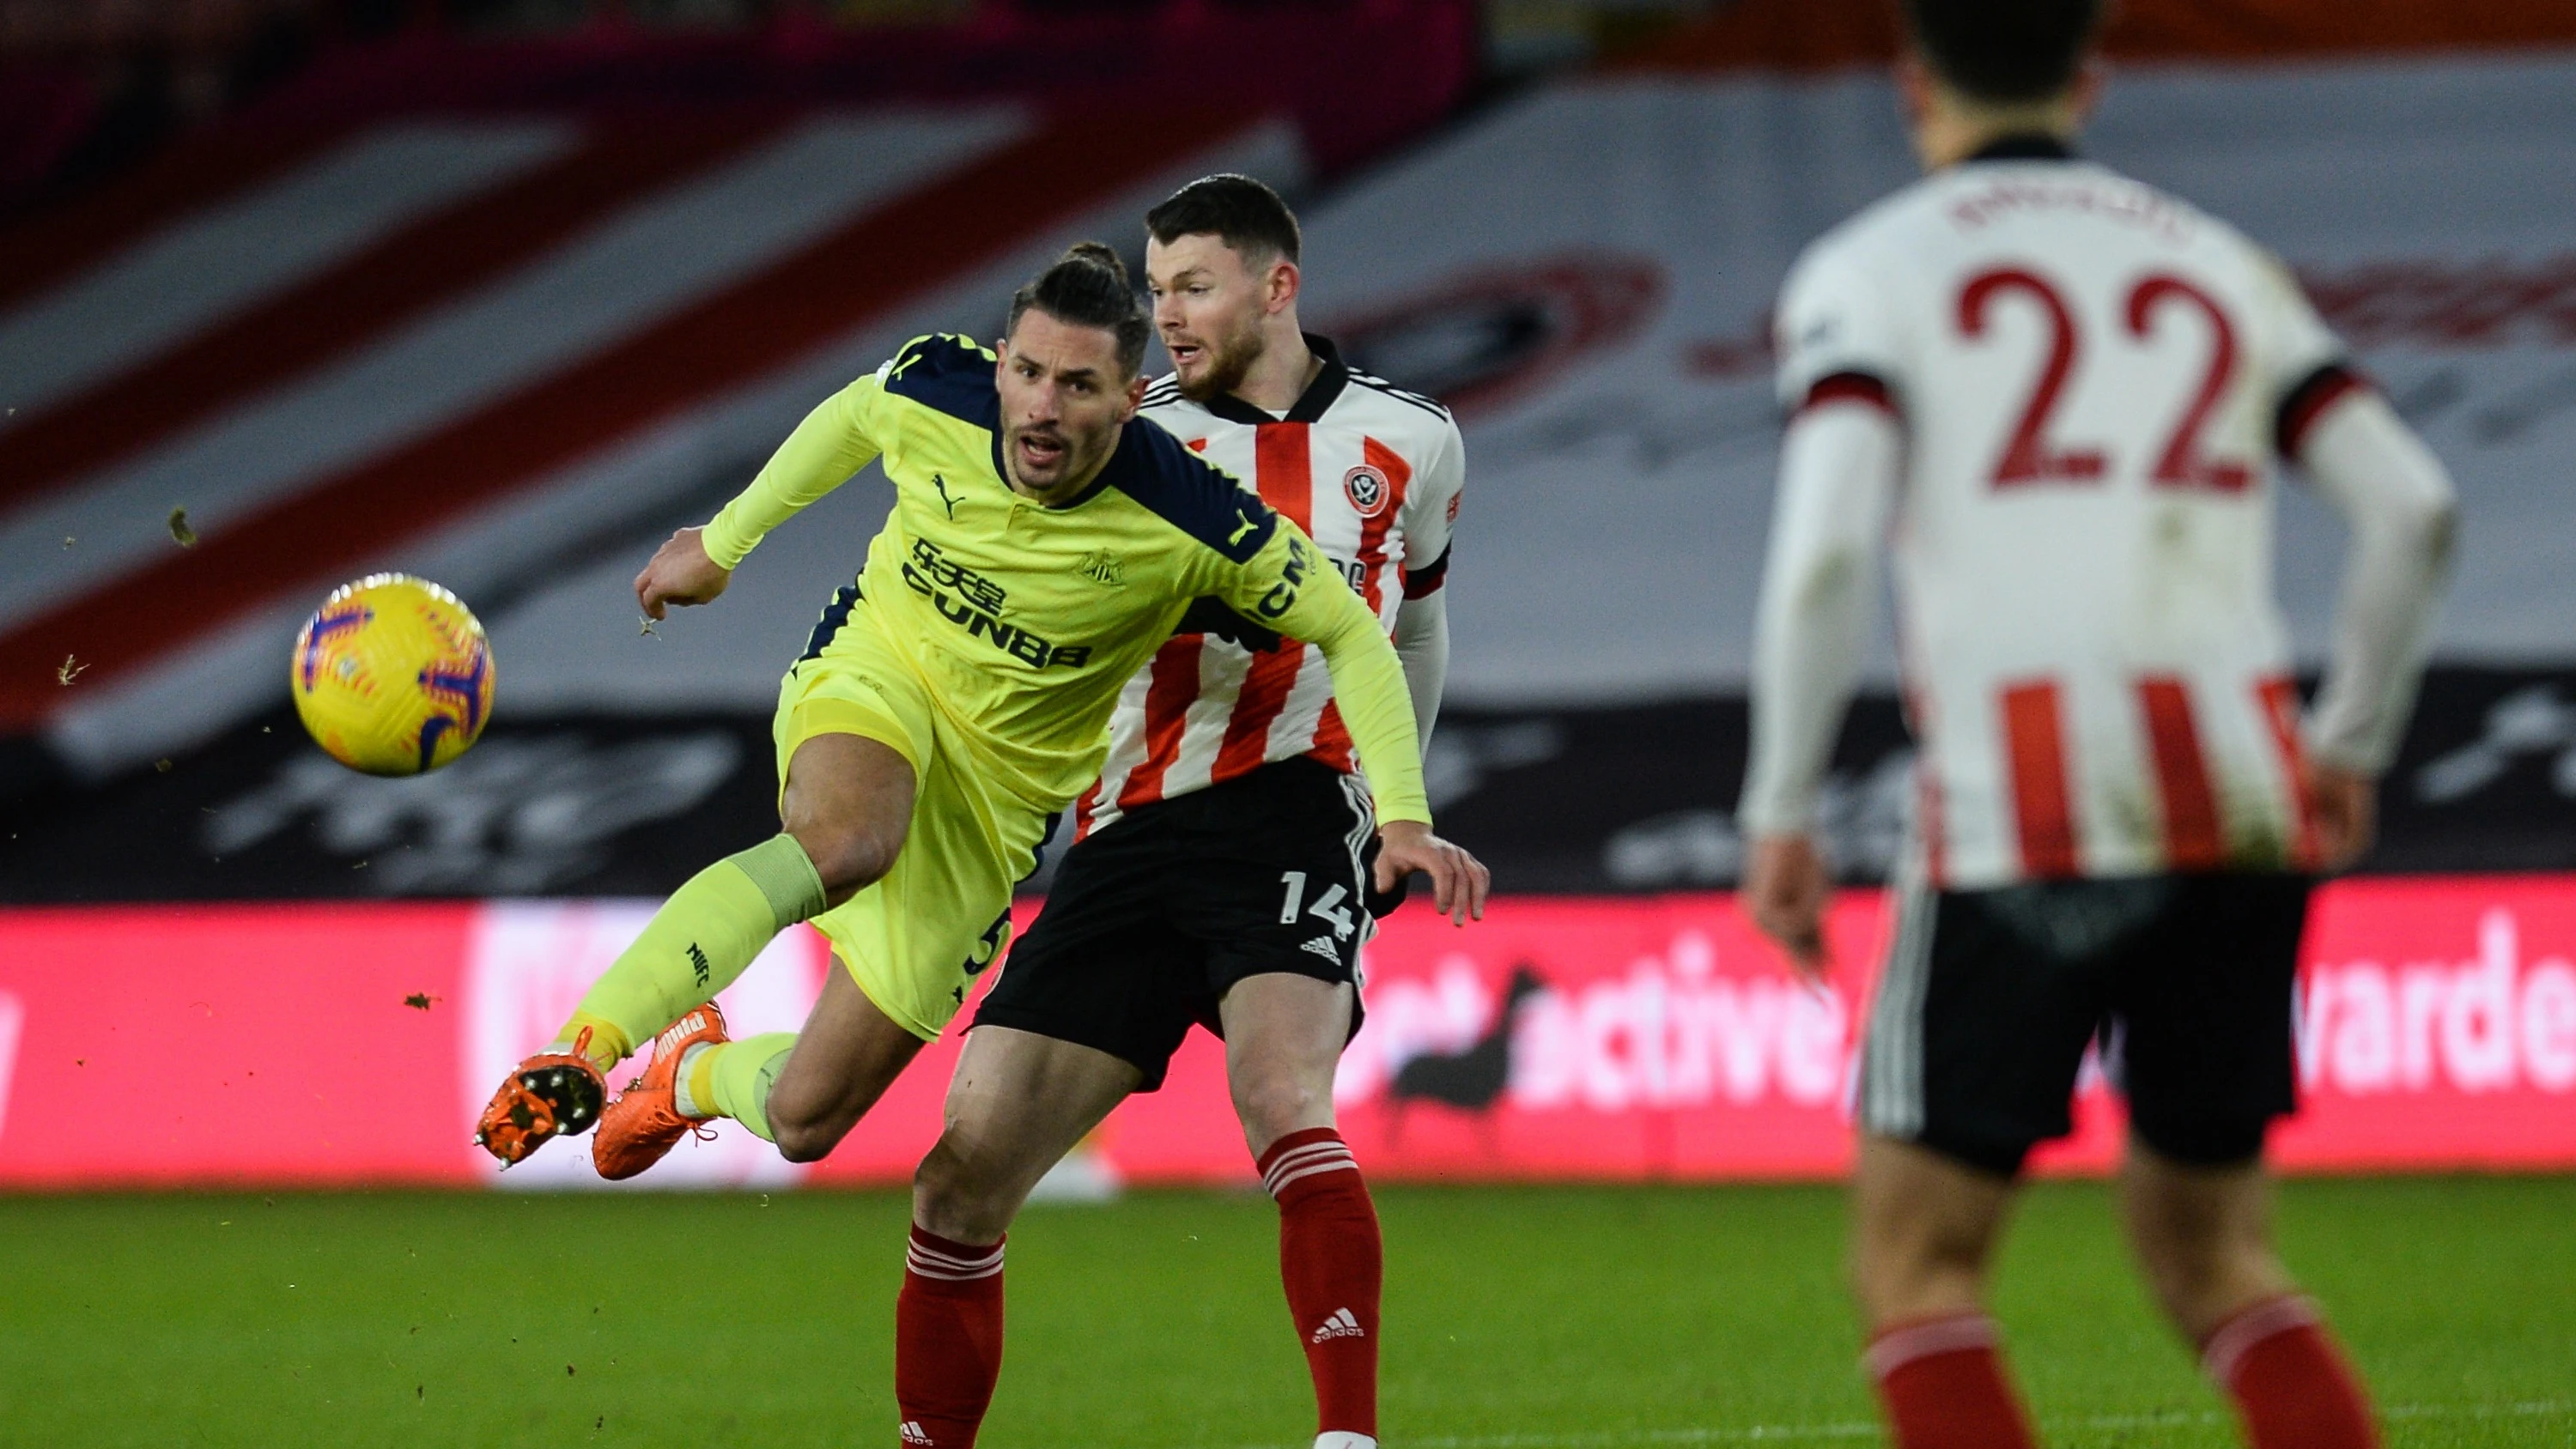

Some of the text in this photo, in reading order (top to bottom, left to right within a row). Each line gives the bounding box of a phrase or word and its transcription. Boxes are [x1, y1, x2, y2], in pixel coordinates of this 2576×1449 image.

[1956, 268, 2254, 491] 22
[913, 537, 1007, 616] 乐天堂
[963, 907, 1012, 975] 5
[1279, 871, 1356, 943] 14
[1312, 1326, 1364, 1344] adidas
